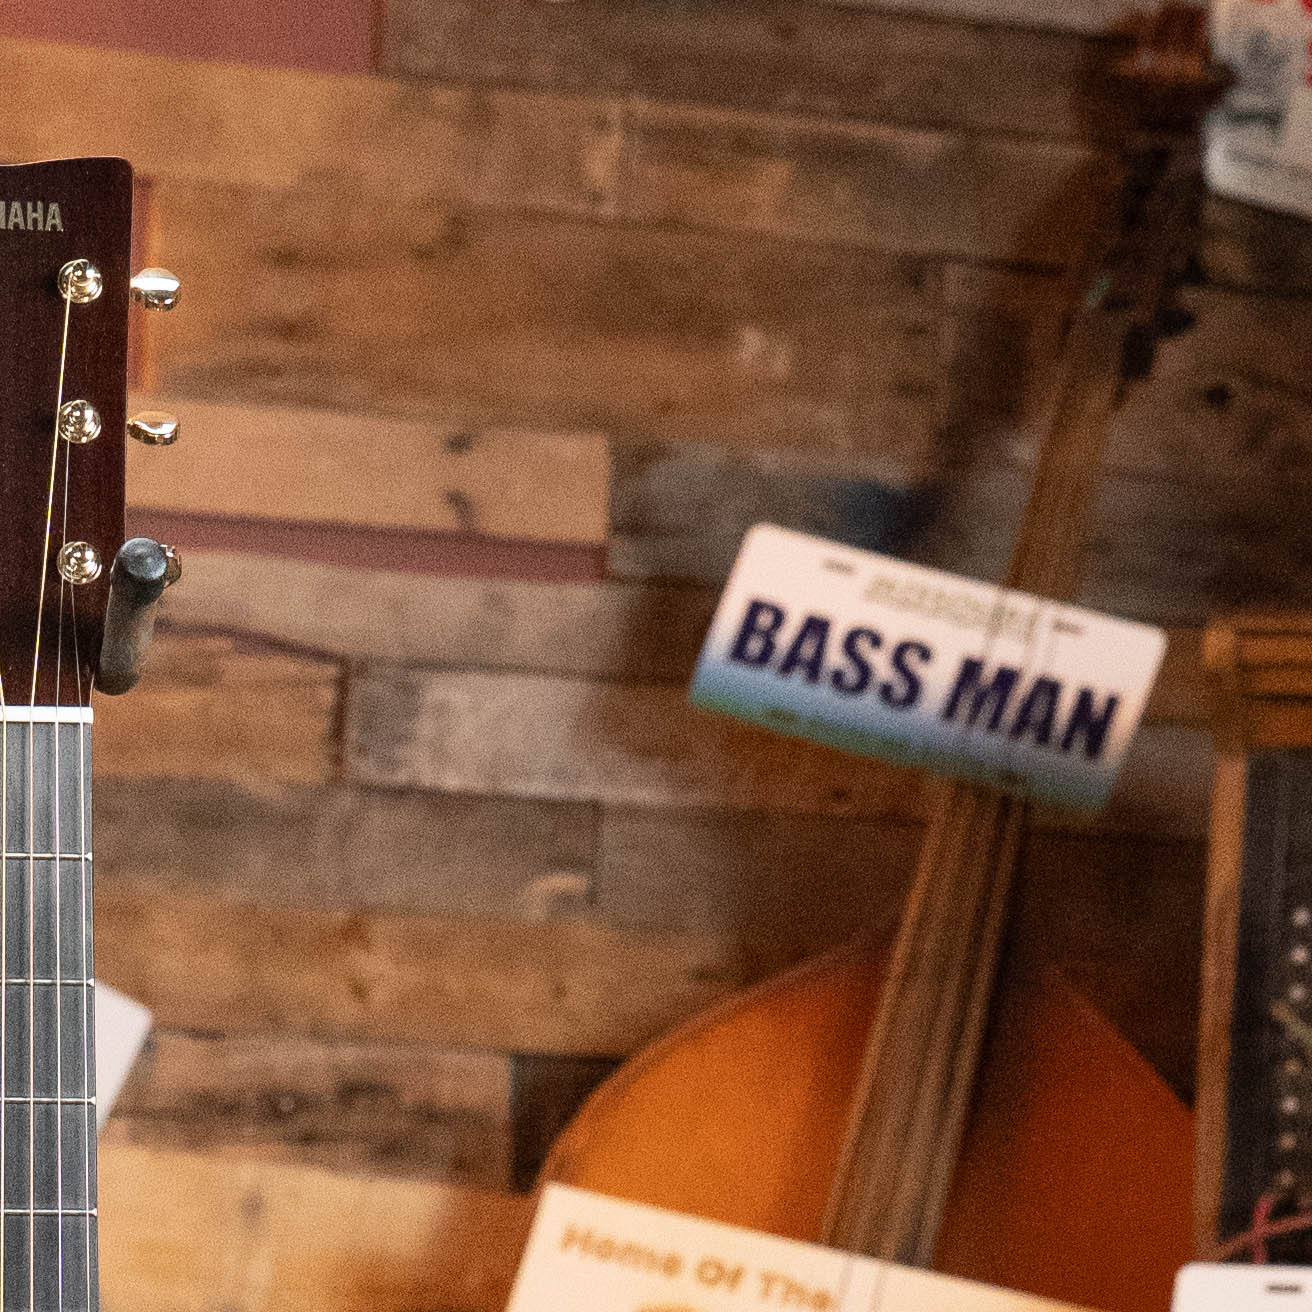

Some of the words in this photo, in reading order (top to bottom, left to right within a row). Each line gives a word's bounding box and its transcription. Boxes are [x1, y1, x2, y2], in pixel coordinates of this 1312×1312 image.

[727, 599, 932, 711] BASS
[940, 656, 1120, 764] MAN
[560, 1222, 683, 1279] Home
[694, 1256, 745, 1292] Of
